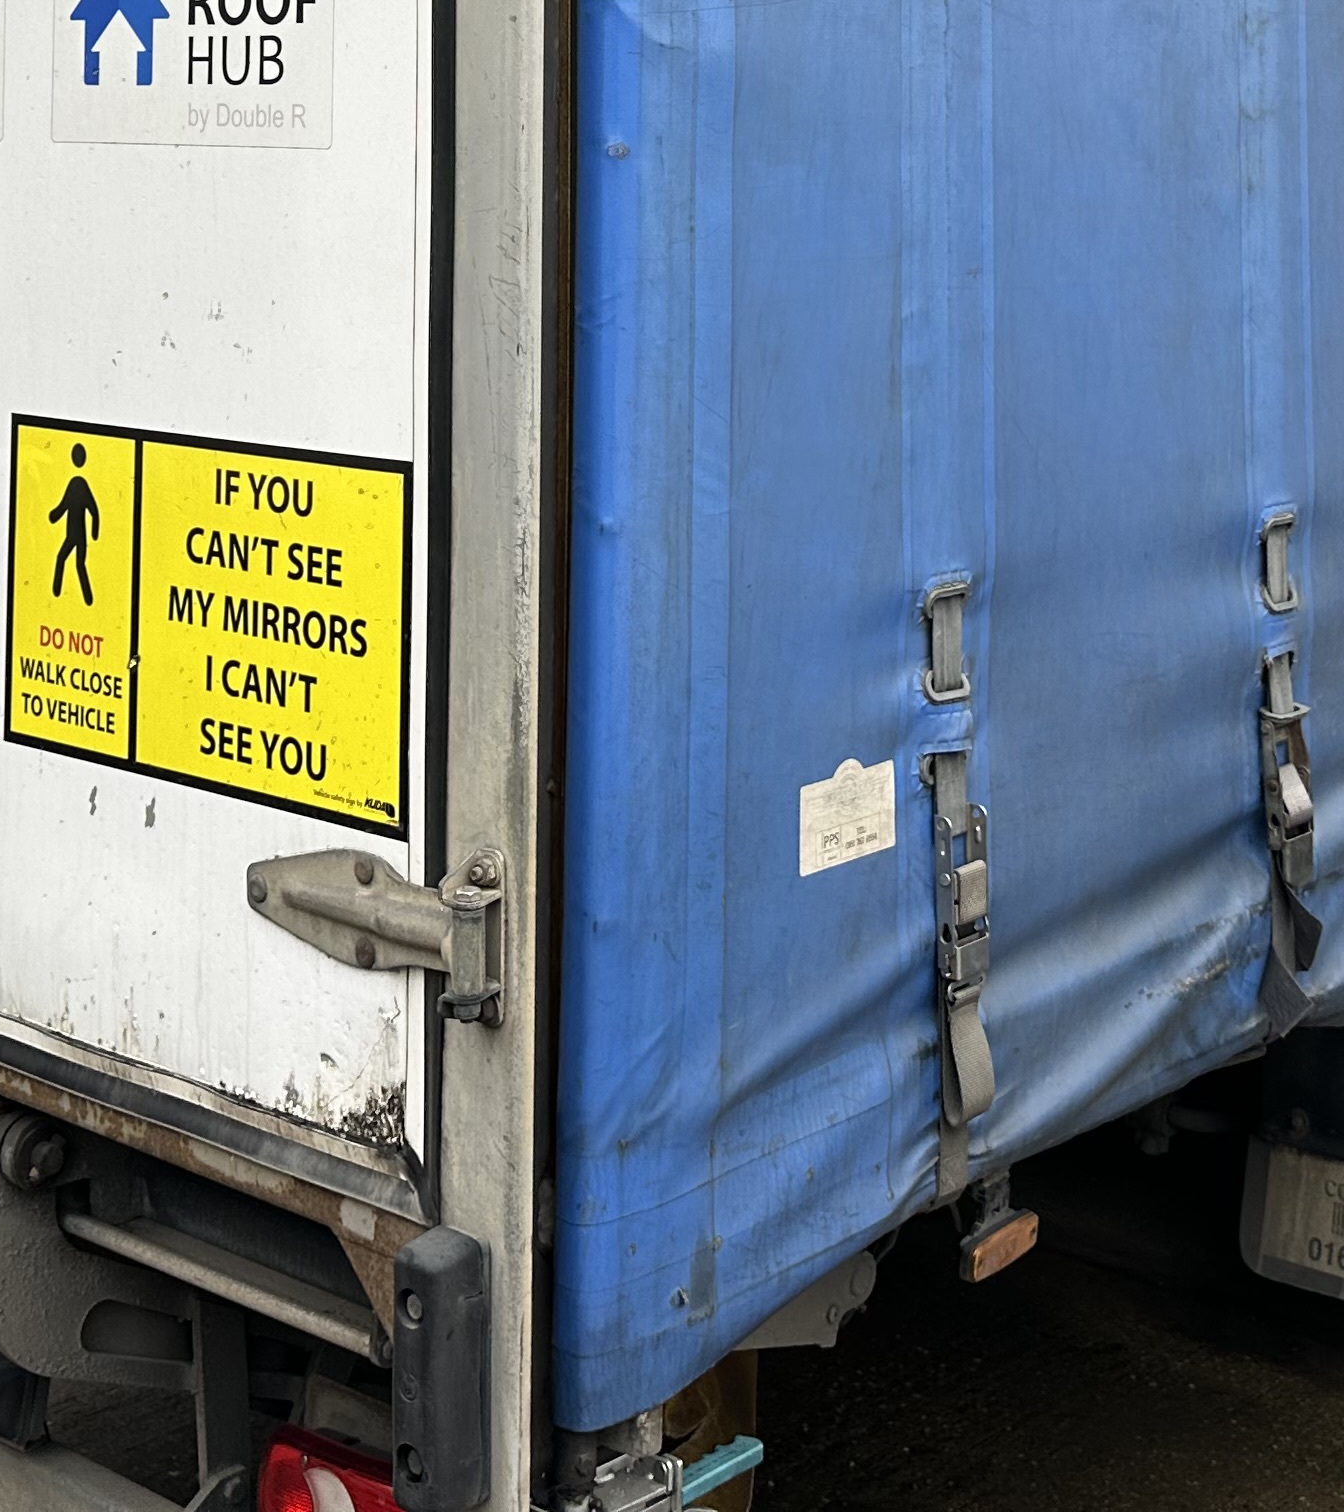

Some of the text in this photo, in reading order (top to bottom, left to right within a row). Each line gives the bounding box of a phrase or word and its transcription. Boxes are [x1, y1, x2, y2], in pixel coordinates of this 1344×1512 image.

[187, 35, 285, 85] HUB
[187, 101, 307, 132] by Double R
[215, 468, 314, 518] IF YOU
[186, 527, 343, 588] CAN'T SEE
[39, 624, 104, 659] DO NOT
[168, 585, 368, 658] MY MIRRORS
[19, 656, 123, 700] WALK CLOSE
[205, 654, 318, 714] I CAN'T
[21, 692, 115, 735] TO VEHICLE
[200, 718, 327, 782] SEE YOU
